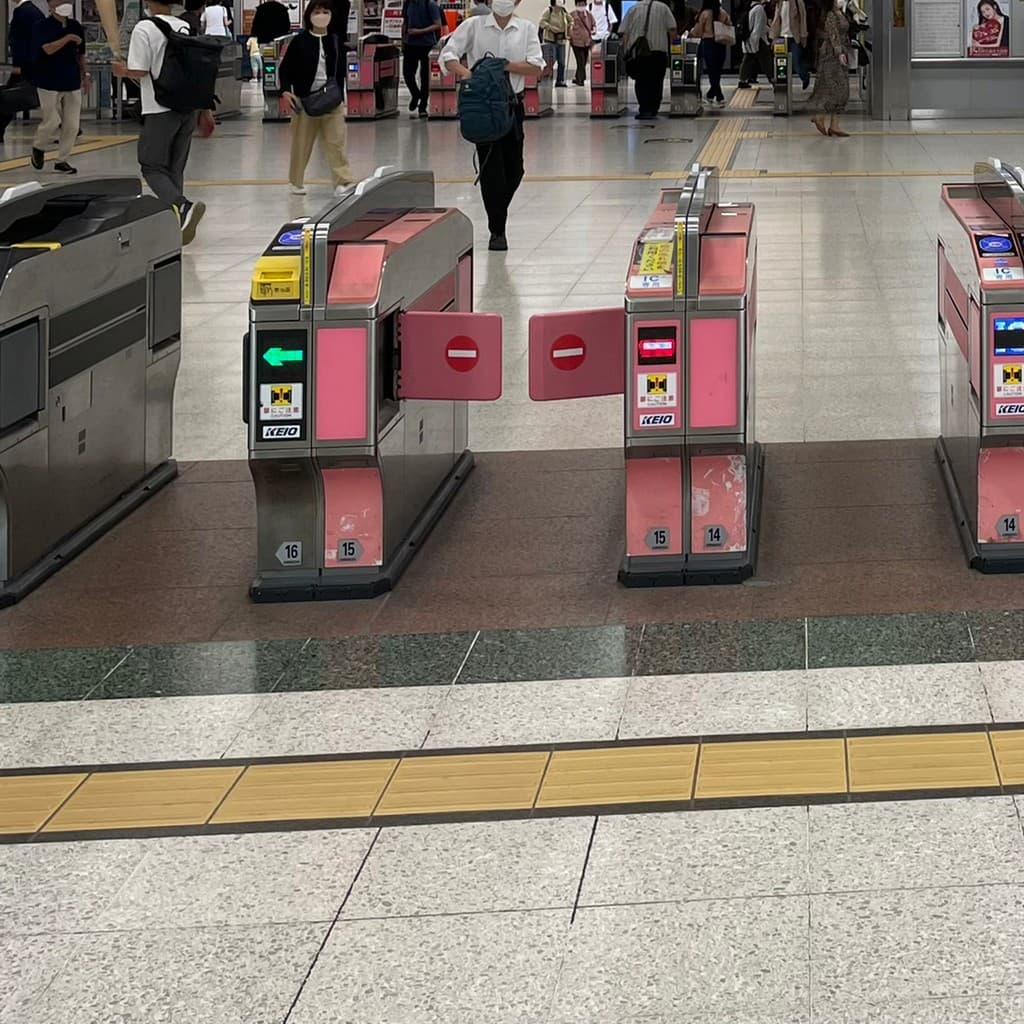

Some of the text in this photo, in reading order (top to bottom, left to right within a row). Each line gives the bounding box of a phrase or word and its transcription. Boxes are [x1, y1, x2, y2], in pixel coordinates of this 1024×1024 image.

[995, 267, 1011, 275] IC
[641, 414, 673, 425] KEIO
[264, 426, 299, 438] KEIO
[1003, 517, 1016, 531] 14
[654, 530, 666, 545] 15
[708, 527, 721, 542] 14
[285, 544, 298, 559] 16
[342, 542, 355, 556] 15
